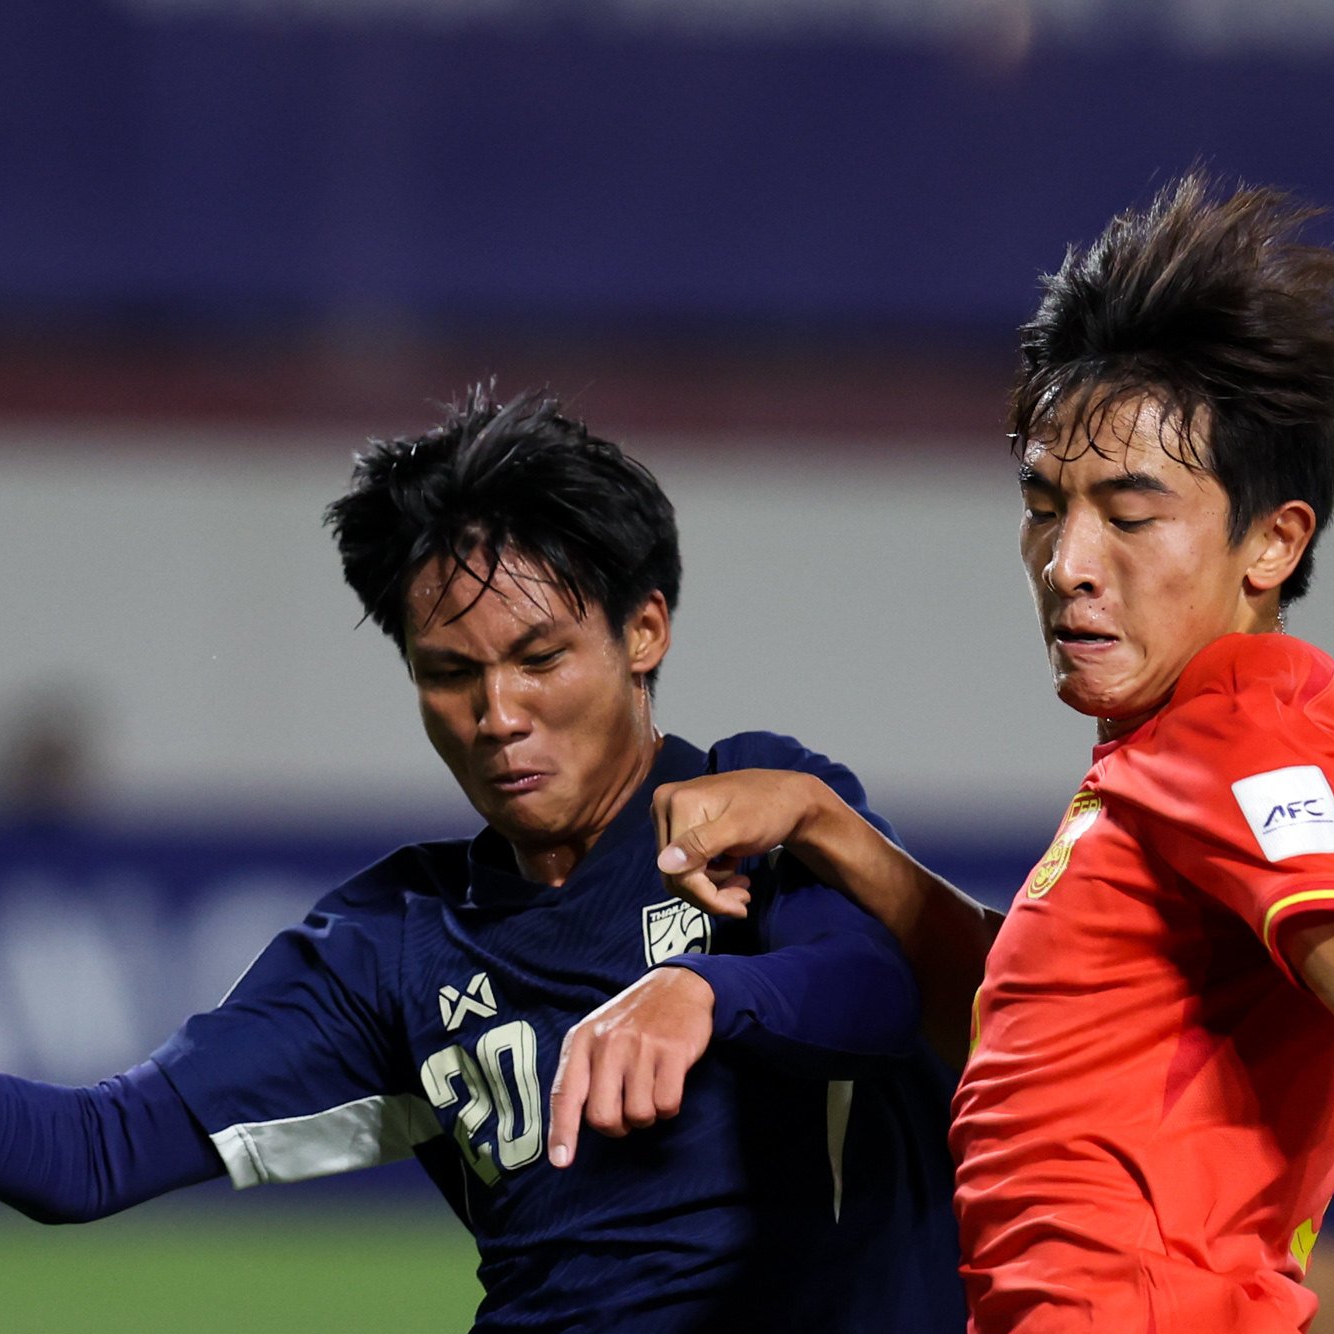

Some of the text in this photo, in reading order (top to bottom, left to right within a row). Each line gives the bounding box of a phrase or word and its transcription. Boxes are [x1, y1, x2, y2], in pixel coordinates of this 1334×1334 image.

[1263, 798, 1325, 828] AFC
[649, 901, 692, 922] THAILA
[420, 1020, 543, 1188] 20
